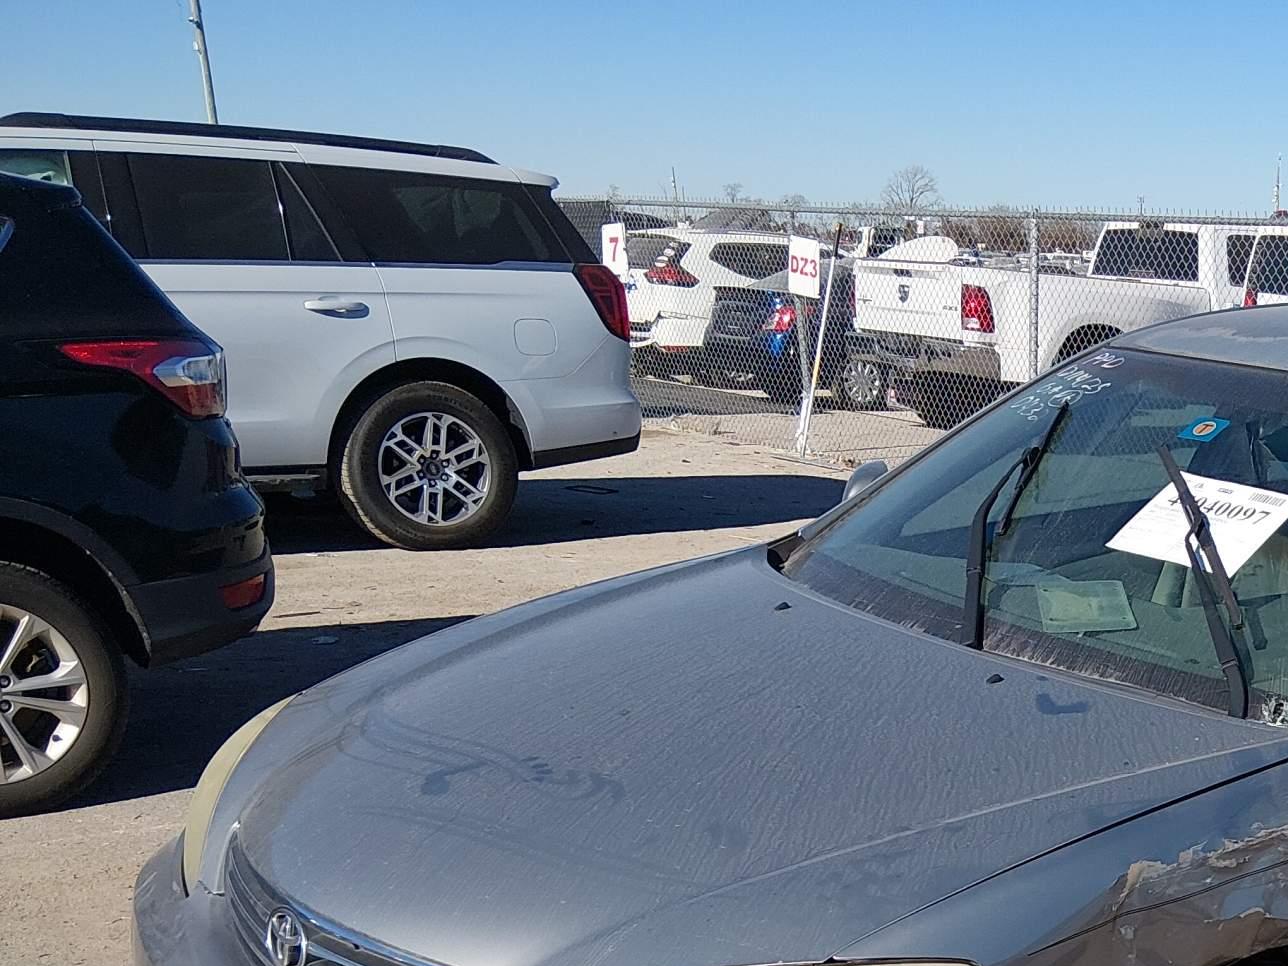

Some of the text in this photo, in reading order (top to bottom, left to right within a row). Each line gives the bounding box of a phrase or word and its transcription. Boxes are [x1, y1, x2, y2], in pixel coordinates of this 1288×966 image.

[608, 236, 619, 263] 7
[790, 255, 818, 278] DZ3
[1168, 497, 1271, 525] 4040097
